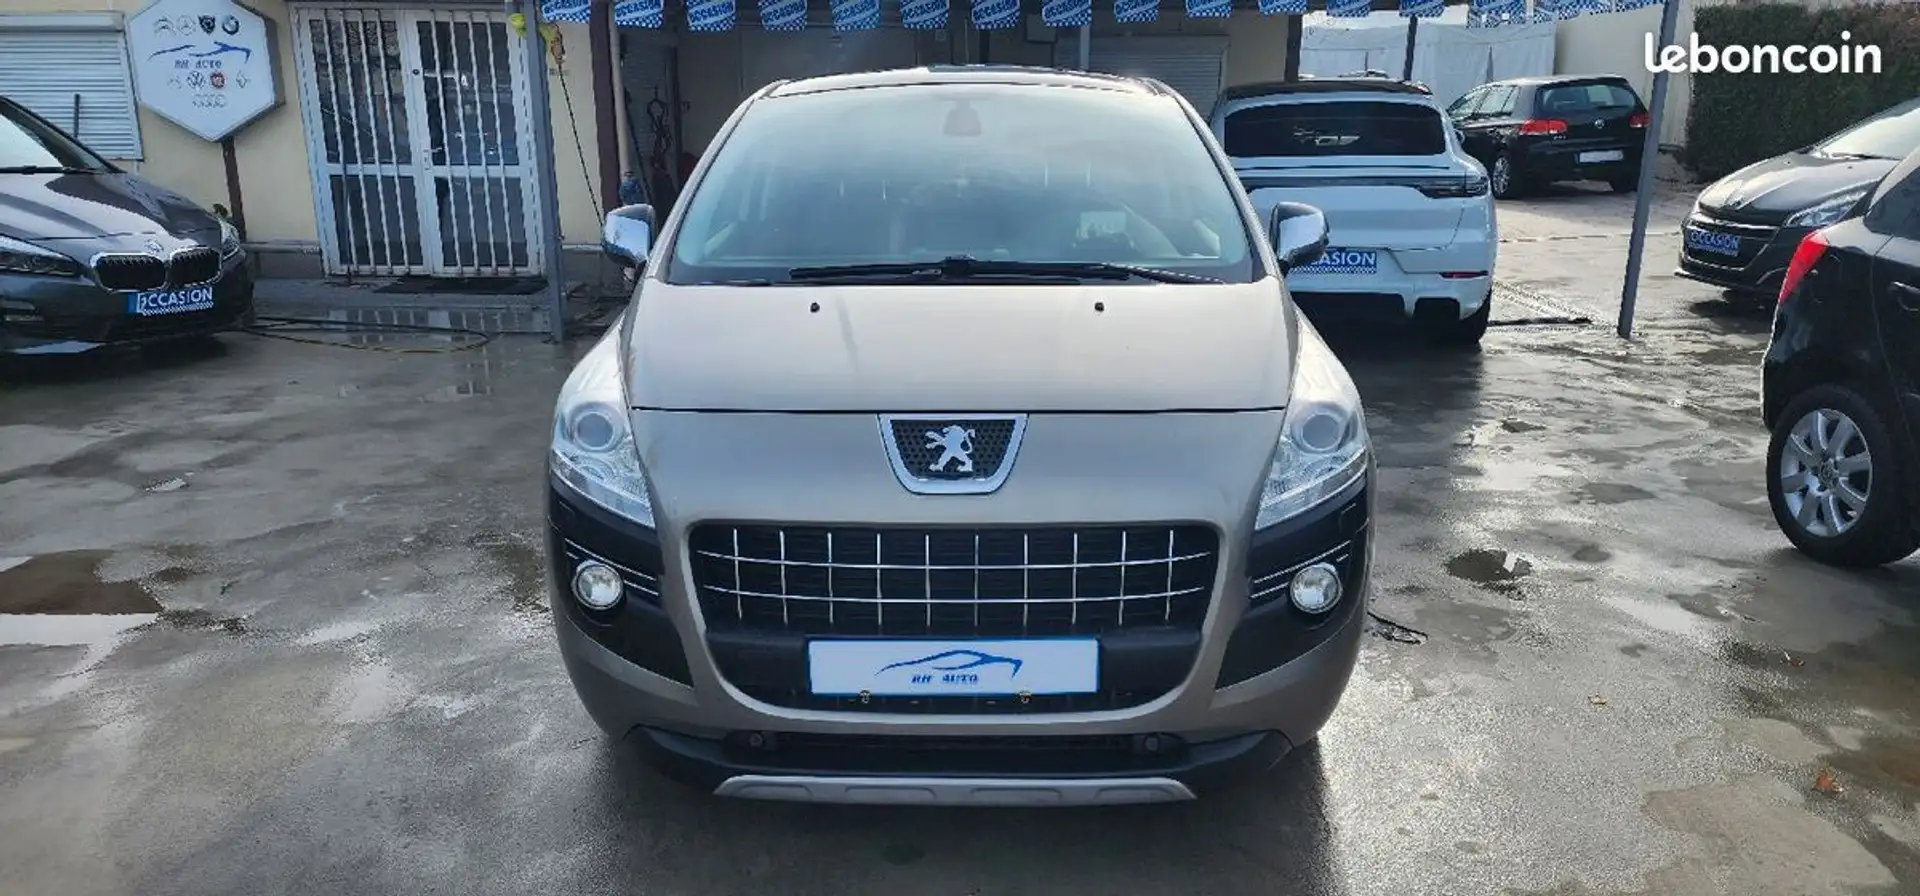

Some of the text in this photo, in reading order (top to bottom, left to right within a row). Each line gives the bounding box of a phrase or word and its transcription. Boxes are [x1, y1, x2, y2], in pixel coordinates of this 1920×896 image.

[1311, 251, 1376, 265] ASION
[911, 674, 978, 685] RH AUTO
